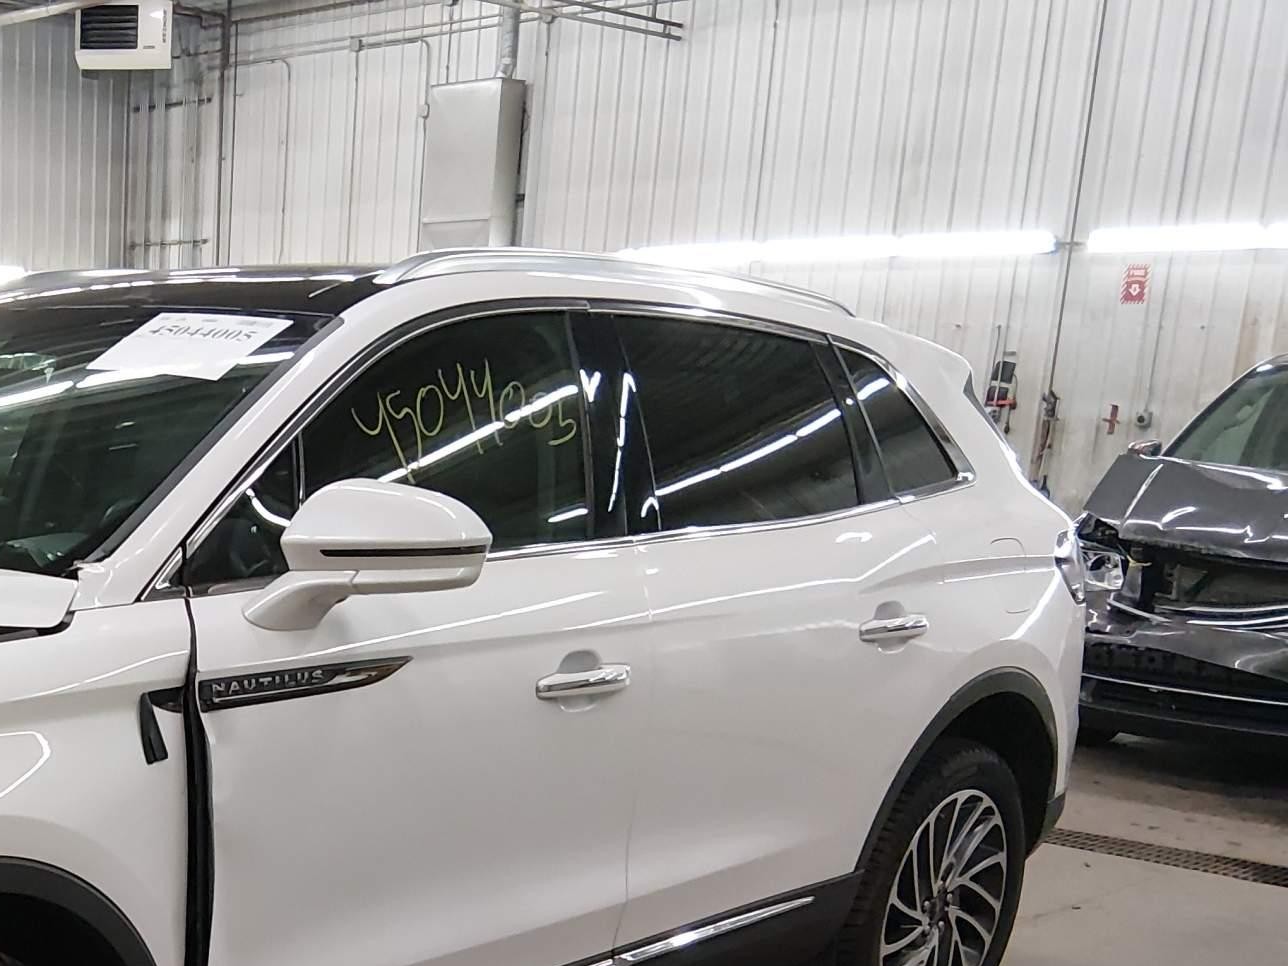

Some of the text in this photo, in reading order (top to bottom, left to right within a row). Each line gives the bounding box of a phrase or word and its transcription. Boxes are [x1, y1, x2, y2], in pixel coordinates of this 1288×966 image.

[149, 324, 258, 342] 45044005
[351, 358, 577, 485] 45044005
[212, 669, 324, 695] NAUTILUS
